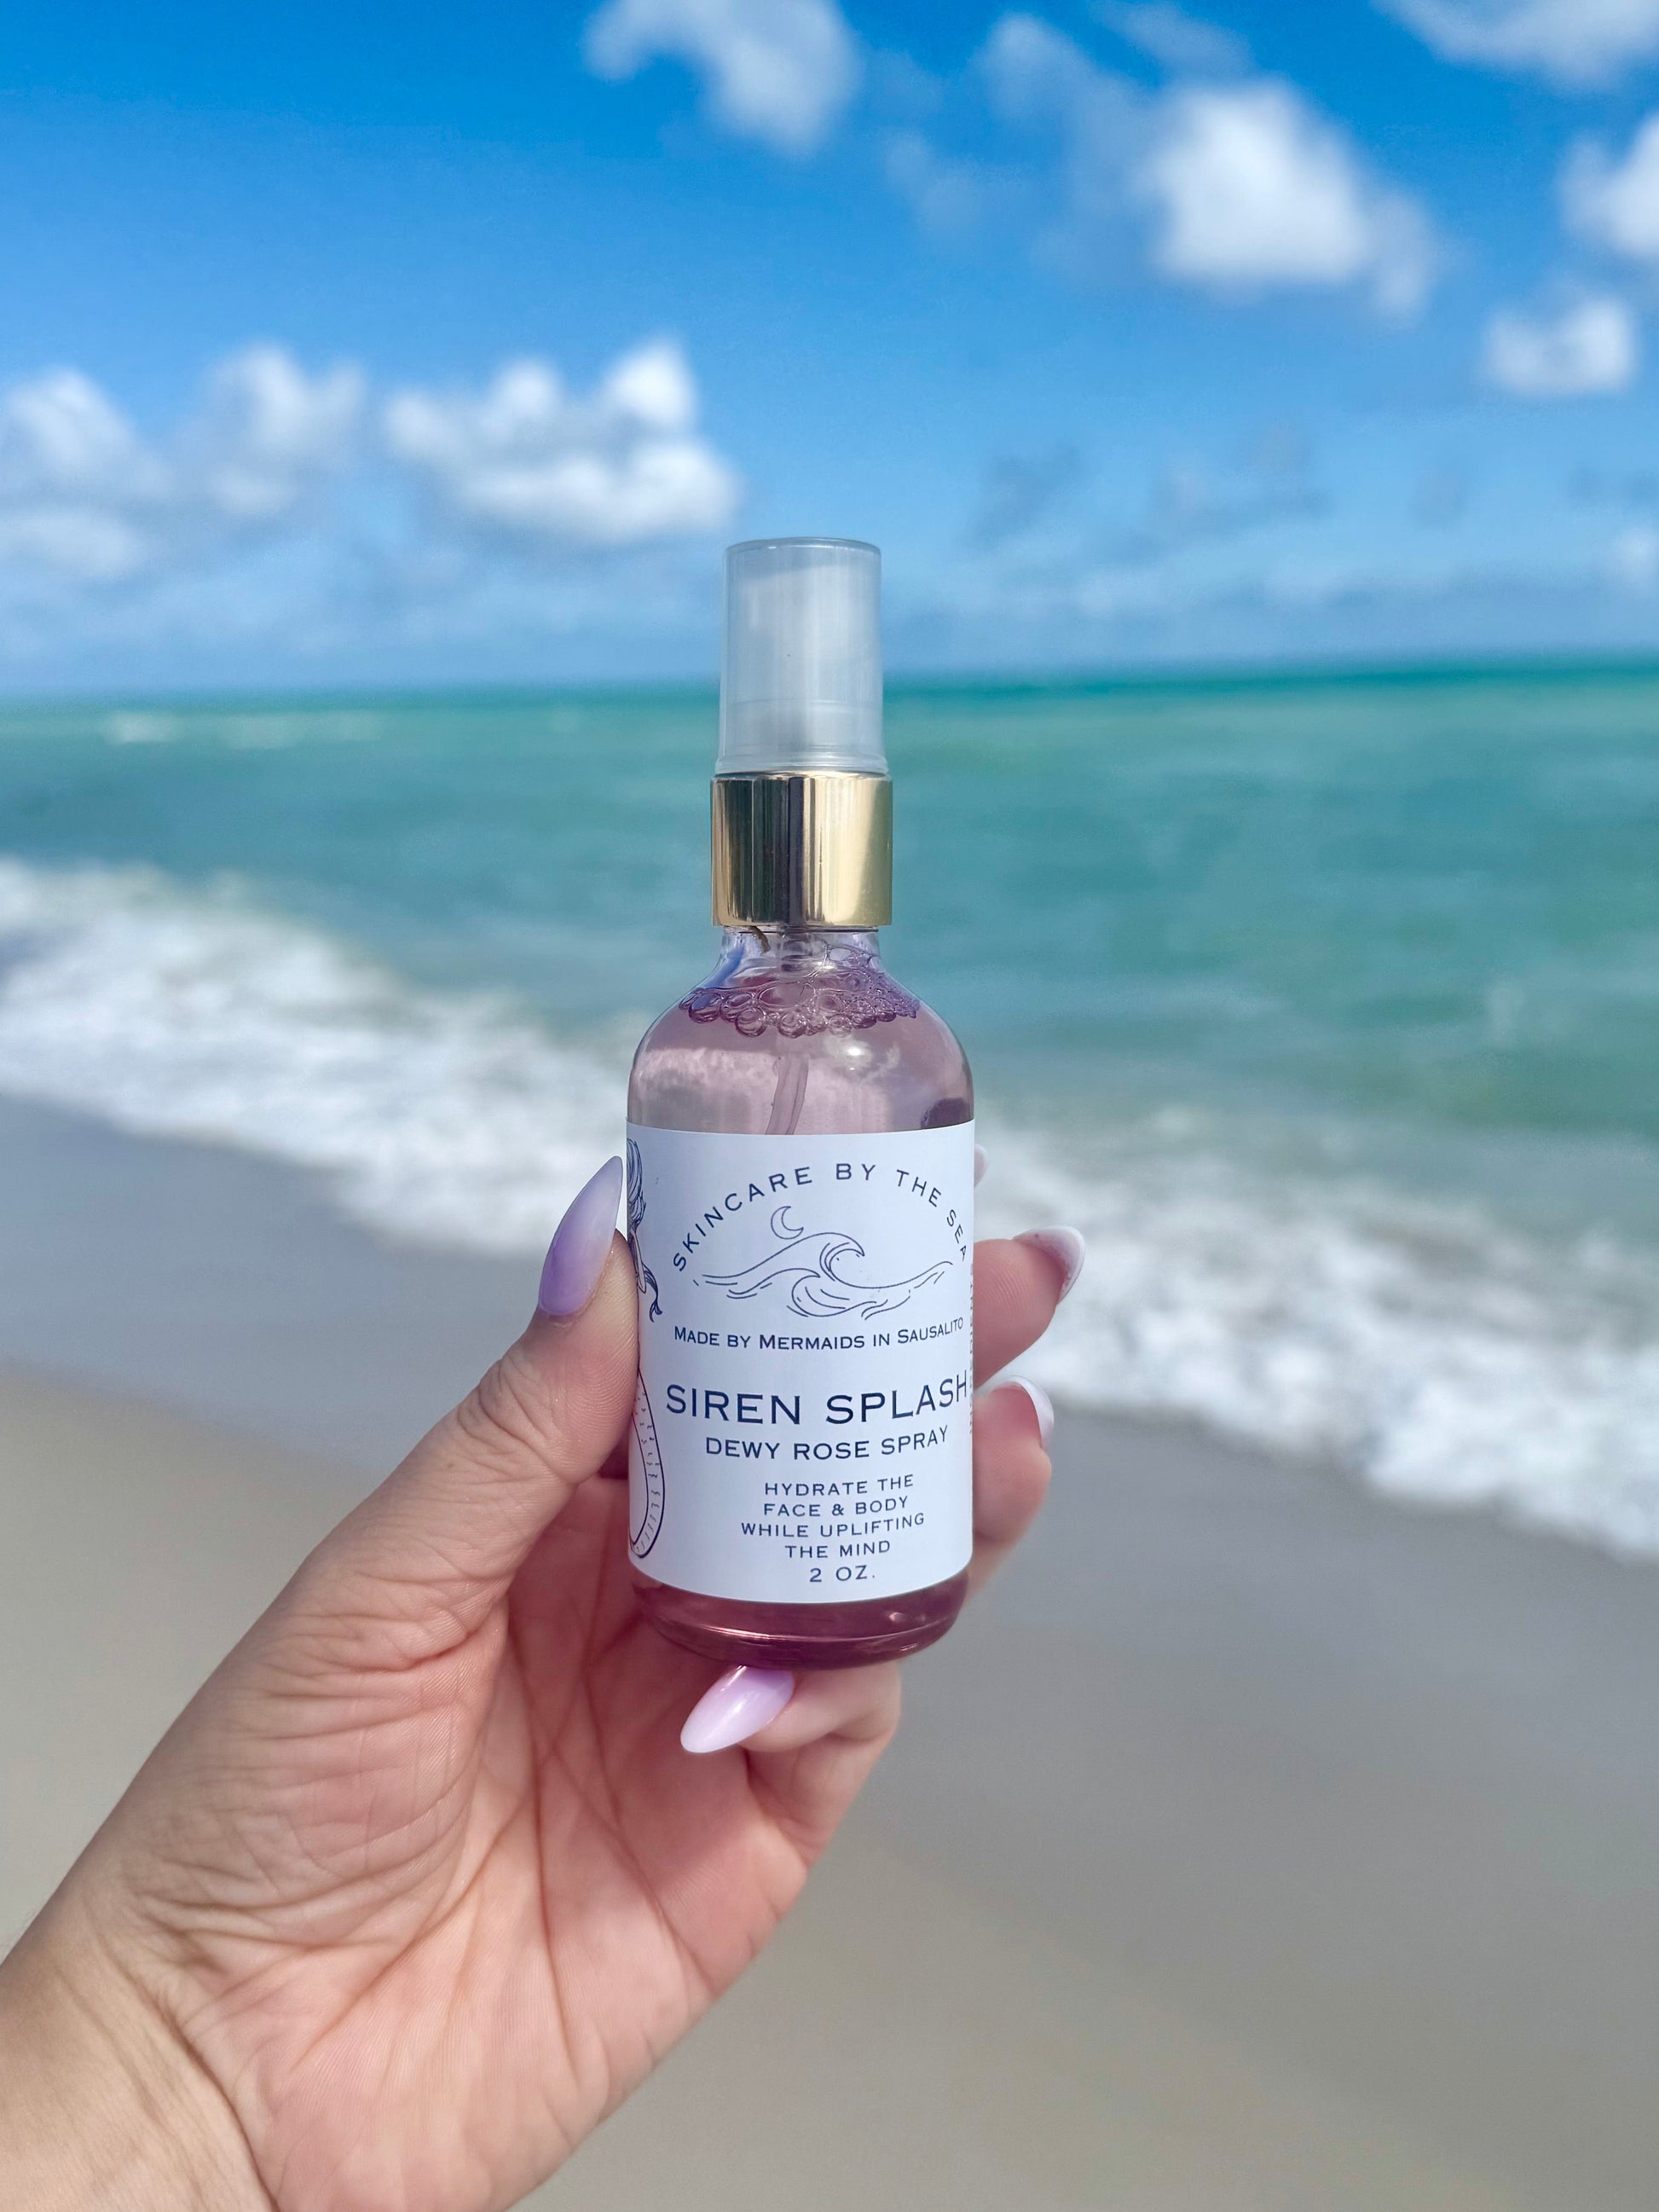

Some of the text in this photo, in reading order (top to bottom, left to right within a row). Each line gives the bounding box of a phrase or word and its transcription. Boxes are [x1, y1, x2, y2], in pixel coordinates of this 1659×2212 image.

[673, 1162, 967, 1272] SKINCARE BY THE SEA
[666, 1369, 967, 1427] SIREN SPLASH
[705, 1424, 948, 1461] DEWY ROSE SPRAY
[765, 1474, 914, 1497] HYDRATE THE
[763, 1495, 908, 1518] FACE & BODY
[741, 1512, 925, 1538] WHILE UPLIFTING
[784, 1539, 891, 1559] THE MIND
[809, 1564, 876, 1584] 2 OZ.
